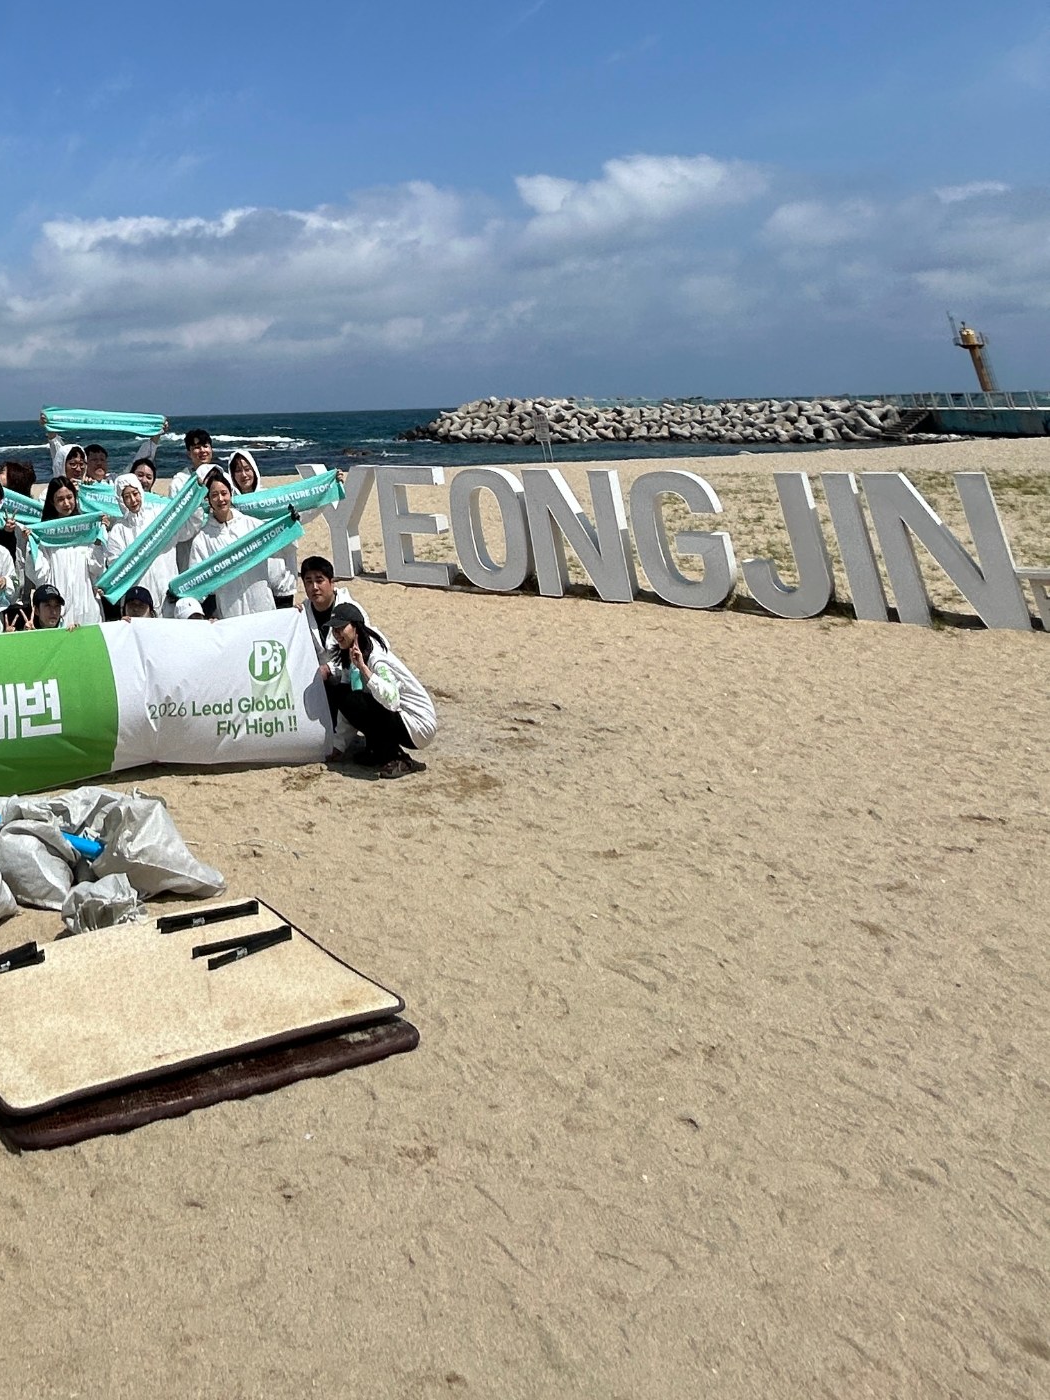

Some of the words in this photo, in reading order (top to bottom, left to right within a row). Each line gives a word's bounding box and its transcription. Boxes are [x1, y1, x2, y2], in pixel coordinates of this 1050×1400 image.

[258, 497, 278, 508] OUR
[278, 490, 310, 504] NATURE
[57, 523, 90, 534] NATURE
[295, 464, 1032, 631] YEONGJIN
[178, 568, 214, 594] REWRITE
[213, 557, 232, 572] OUR
[231, 539, 264, 562] NATURE
[148, 702, 187, 720] 2026
[192, 698, 234, 717] Lead
[237, 693, 296, 714] Global,
[216, 720, 242, 740] Fly
[246, 717, 285, 738] High
